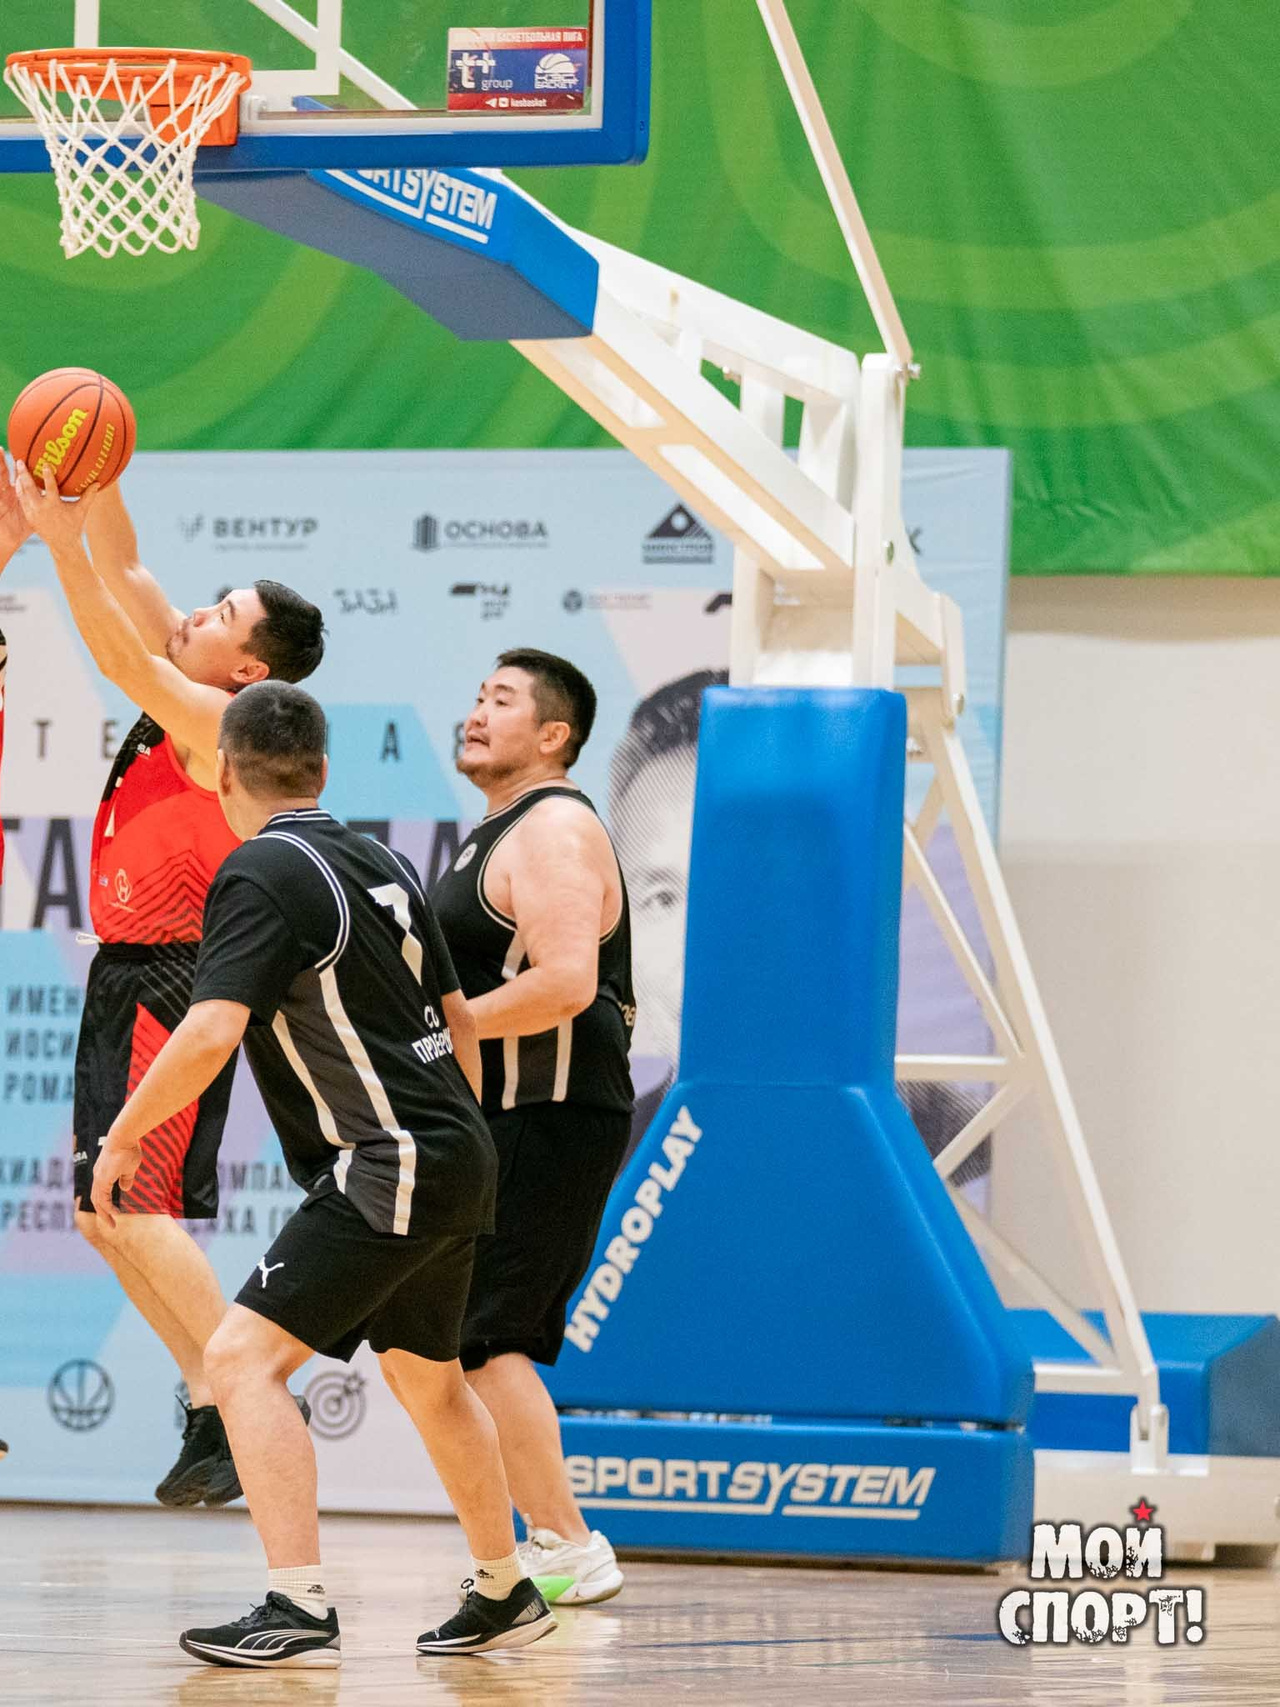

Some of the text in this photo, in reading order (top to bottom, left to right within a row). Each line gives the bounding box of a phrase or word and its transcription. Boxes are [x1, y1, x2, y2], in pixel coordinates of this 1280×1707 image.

[481, 79, 513, 91] group
[356, 169, 498, 230] RTSYSTEM
[33, 408, 89, 478] Wilson
[213, 517, 319, 539] ВЕНТУР
[444, 520, 549, 539] ОСНОВА
[367, 882, 424, 987] 7
[6, 985, 84, 1015] ИМЕН
[5, 1029, 76, 1060] ИОСИ
[3, 1071, 74, 1103] РОМА
[564, 1105, 703, 1353] HYDROPLAY
[565, 1454, 936, 1516] SPORTSYSTEM
